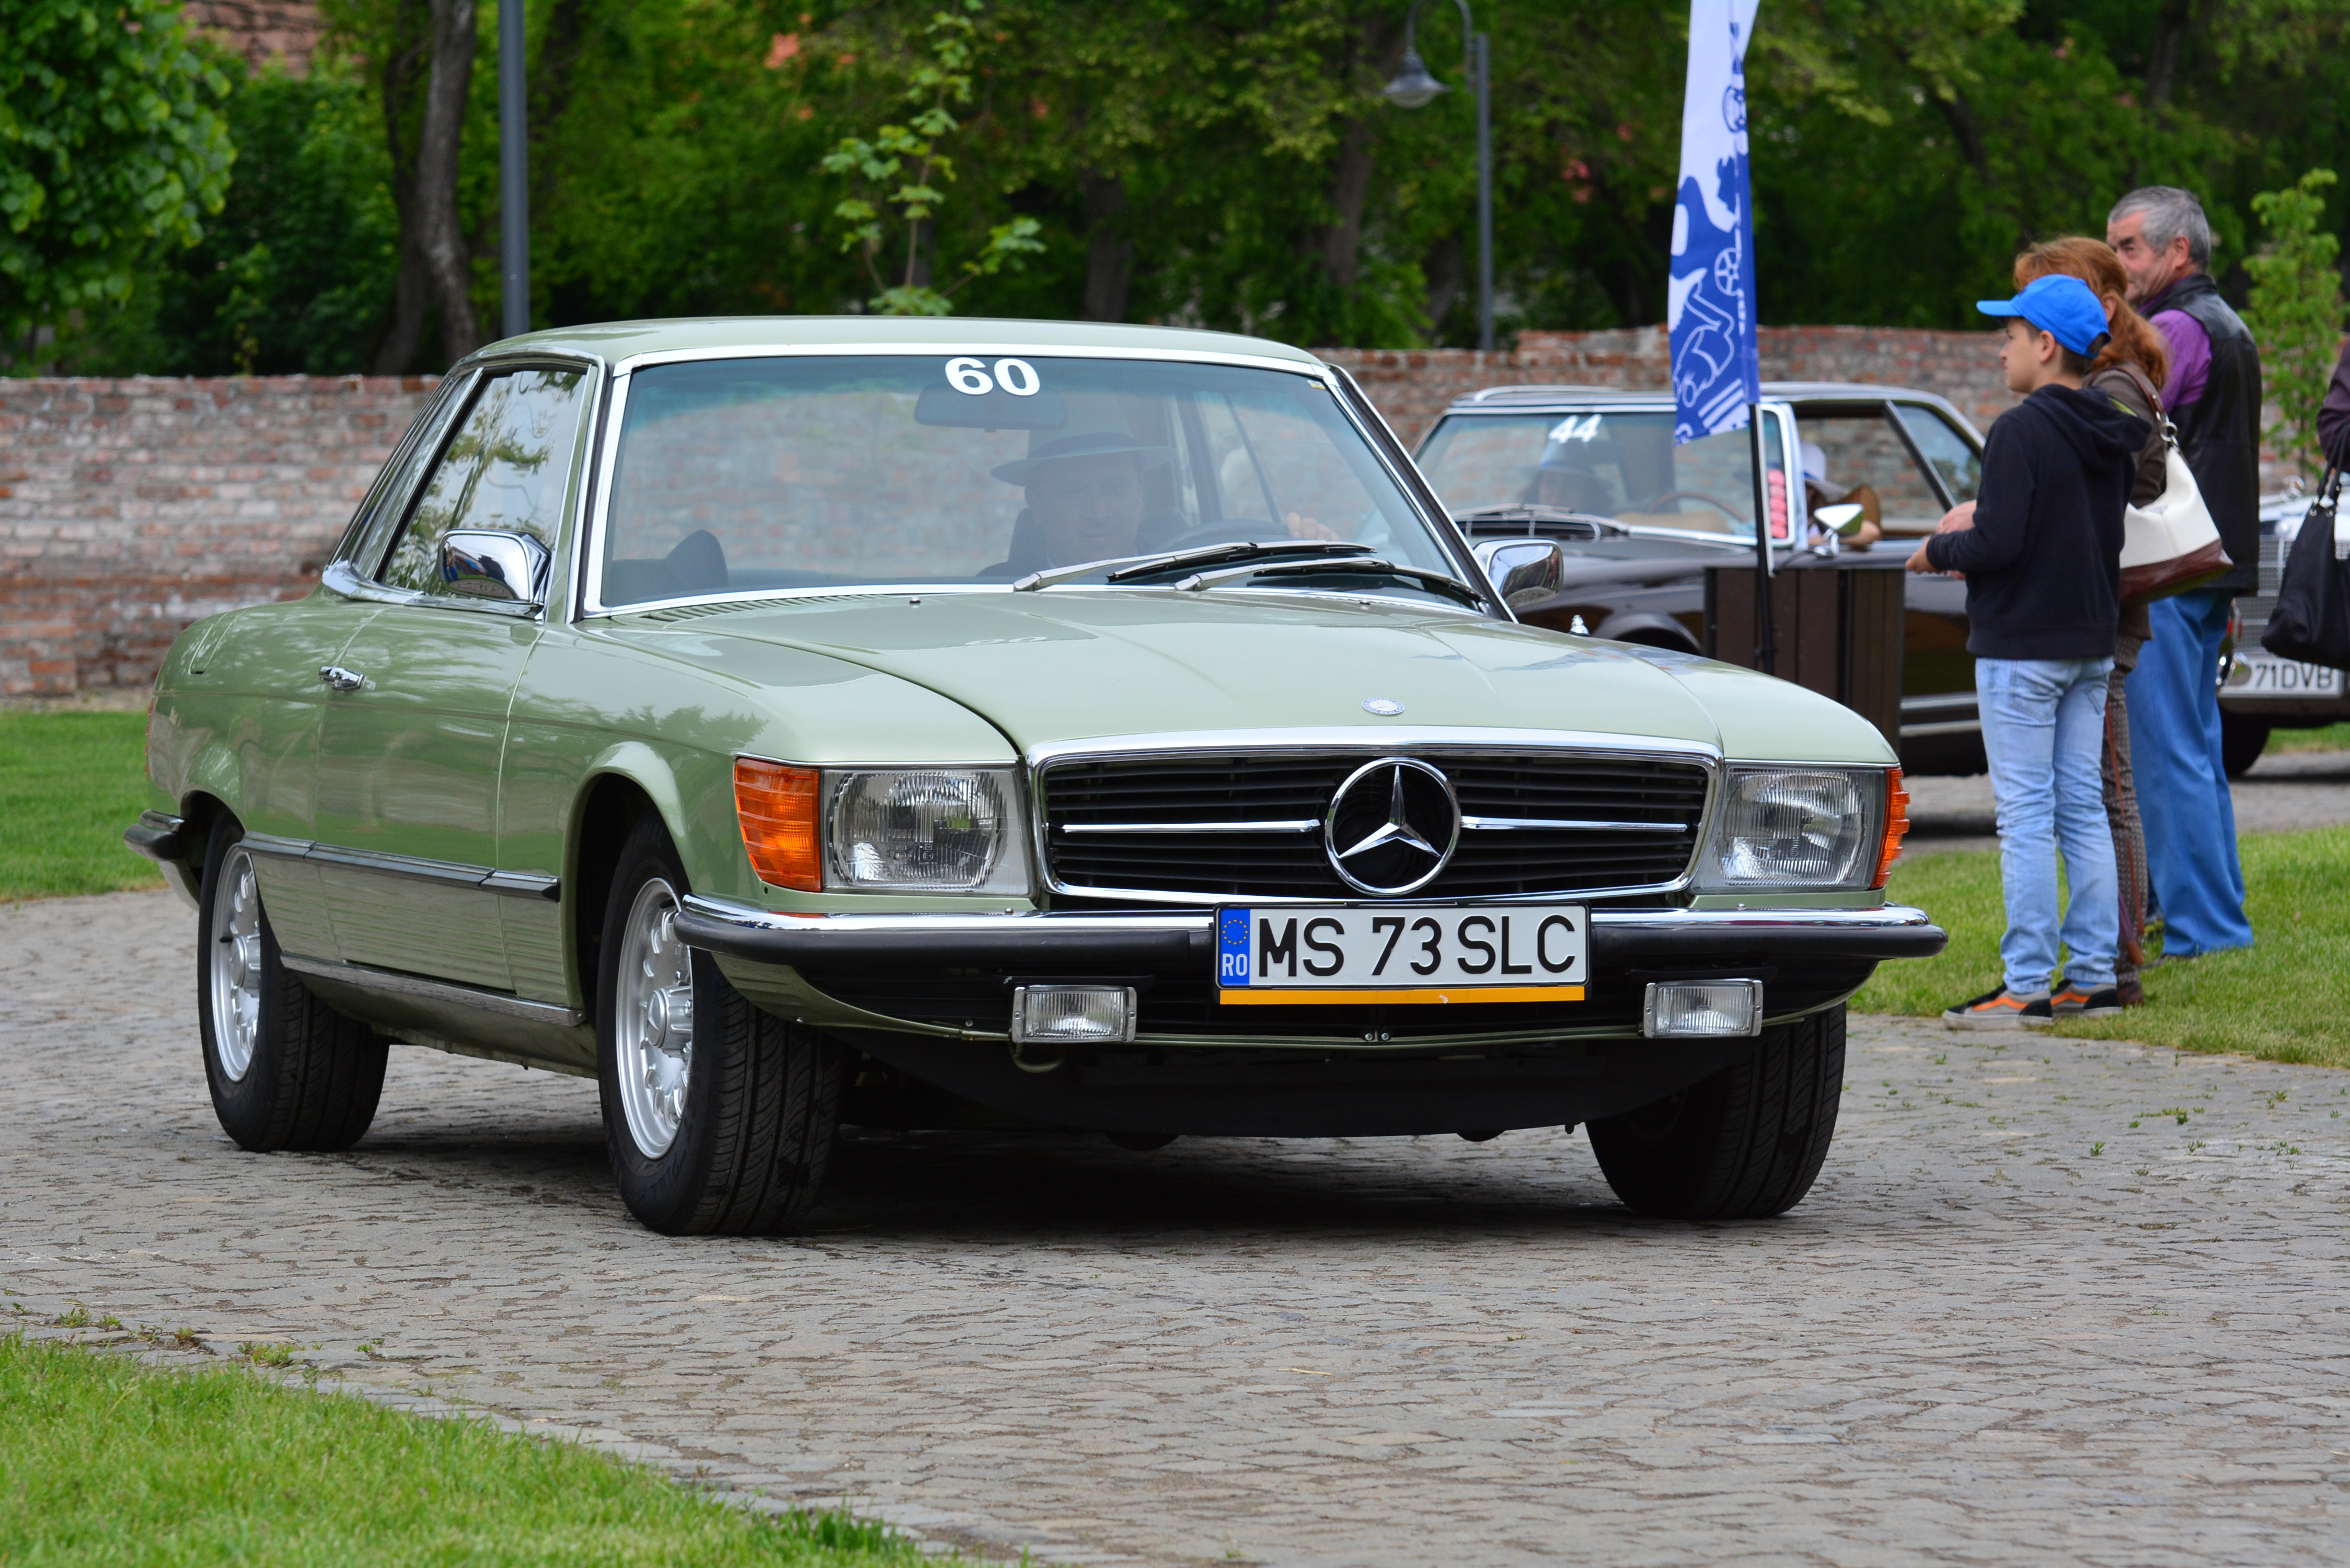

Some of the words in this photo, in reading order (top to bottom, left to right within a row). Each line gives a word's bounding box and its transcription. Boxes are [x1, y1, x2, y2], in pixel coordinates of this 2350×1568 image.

[945, 357, 1041, 396] 60
[1548, 414, 1603, 444] 44
[2255, 664, 2276, 688] 71
[2282, 663, 2332, 689] DVB
[1259, 917, 1345, 977] MS
[1372, 916, 1442, 976] 73
[1457, 914, 1575, 974] SLC
[1222, 953, 1248, 976] RO
